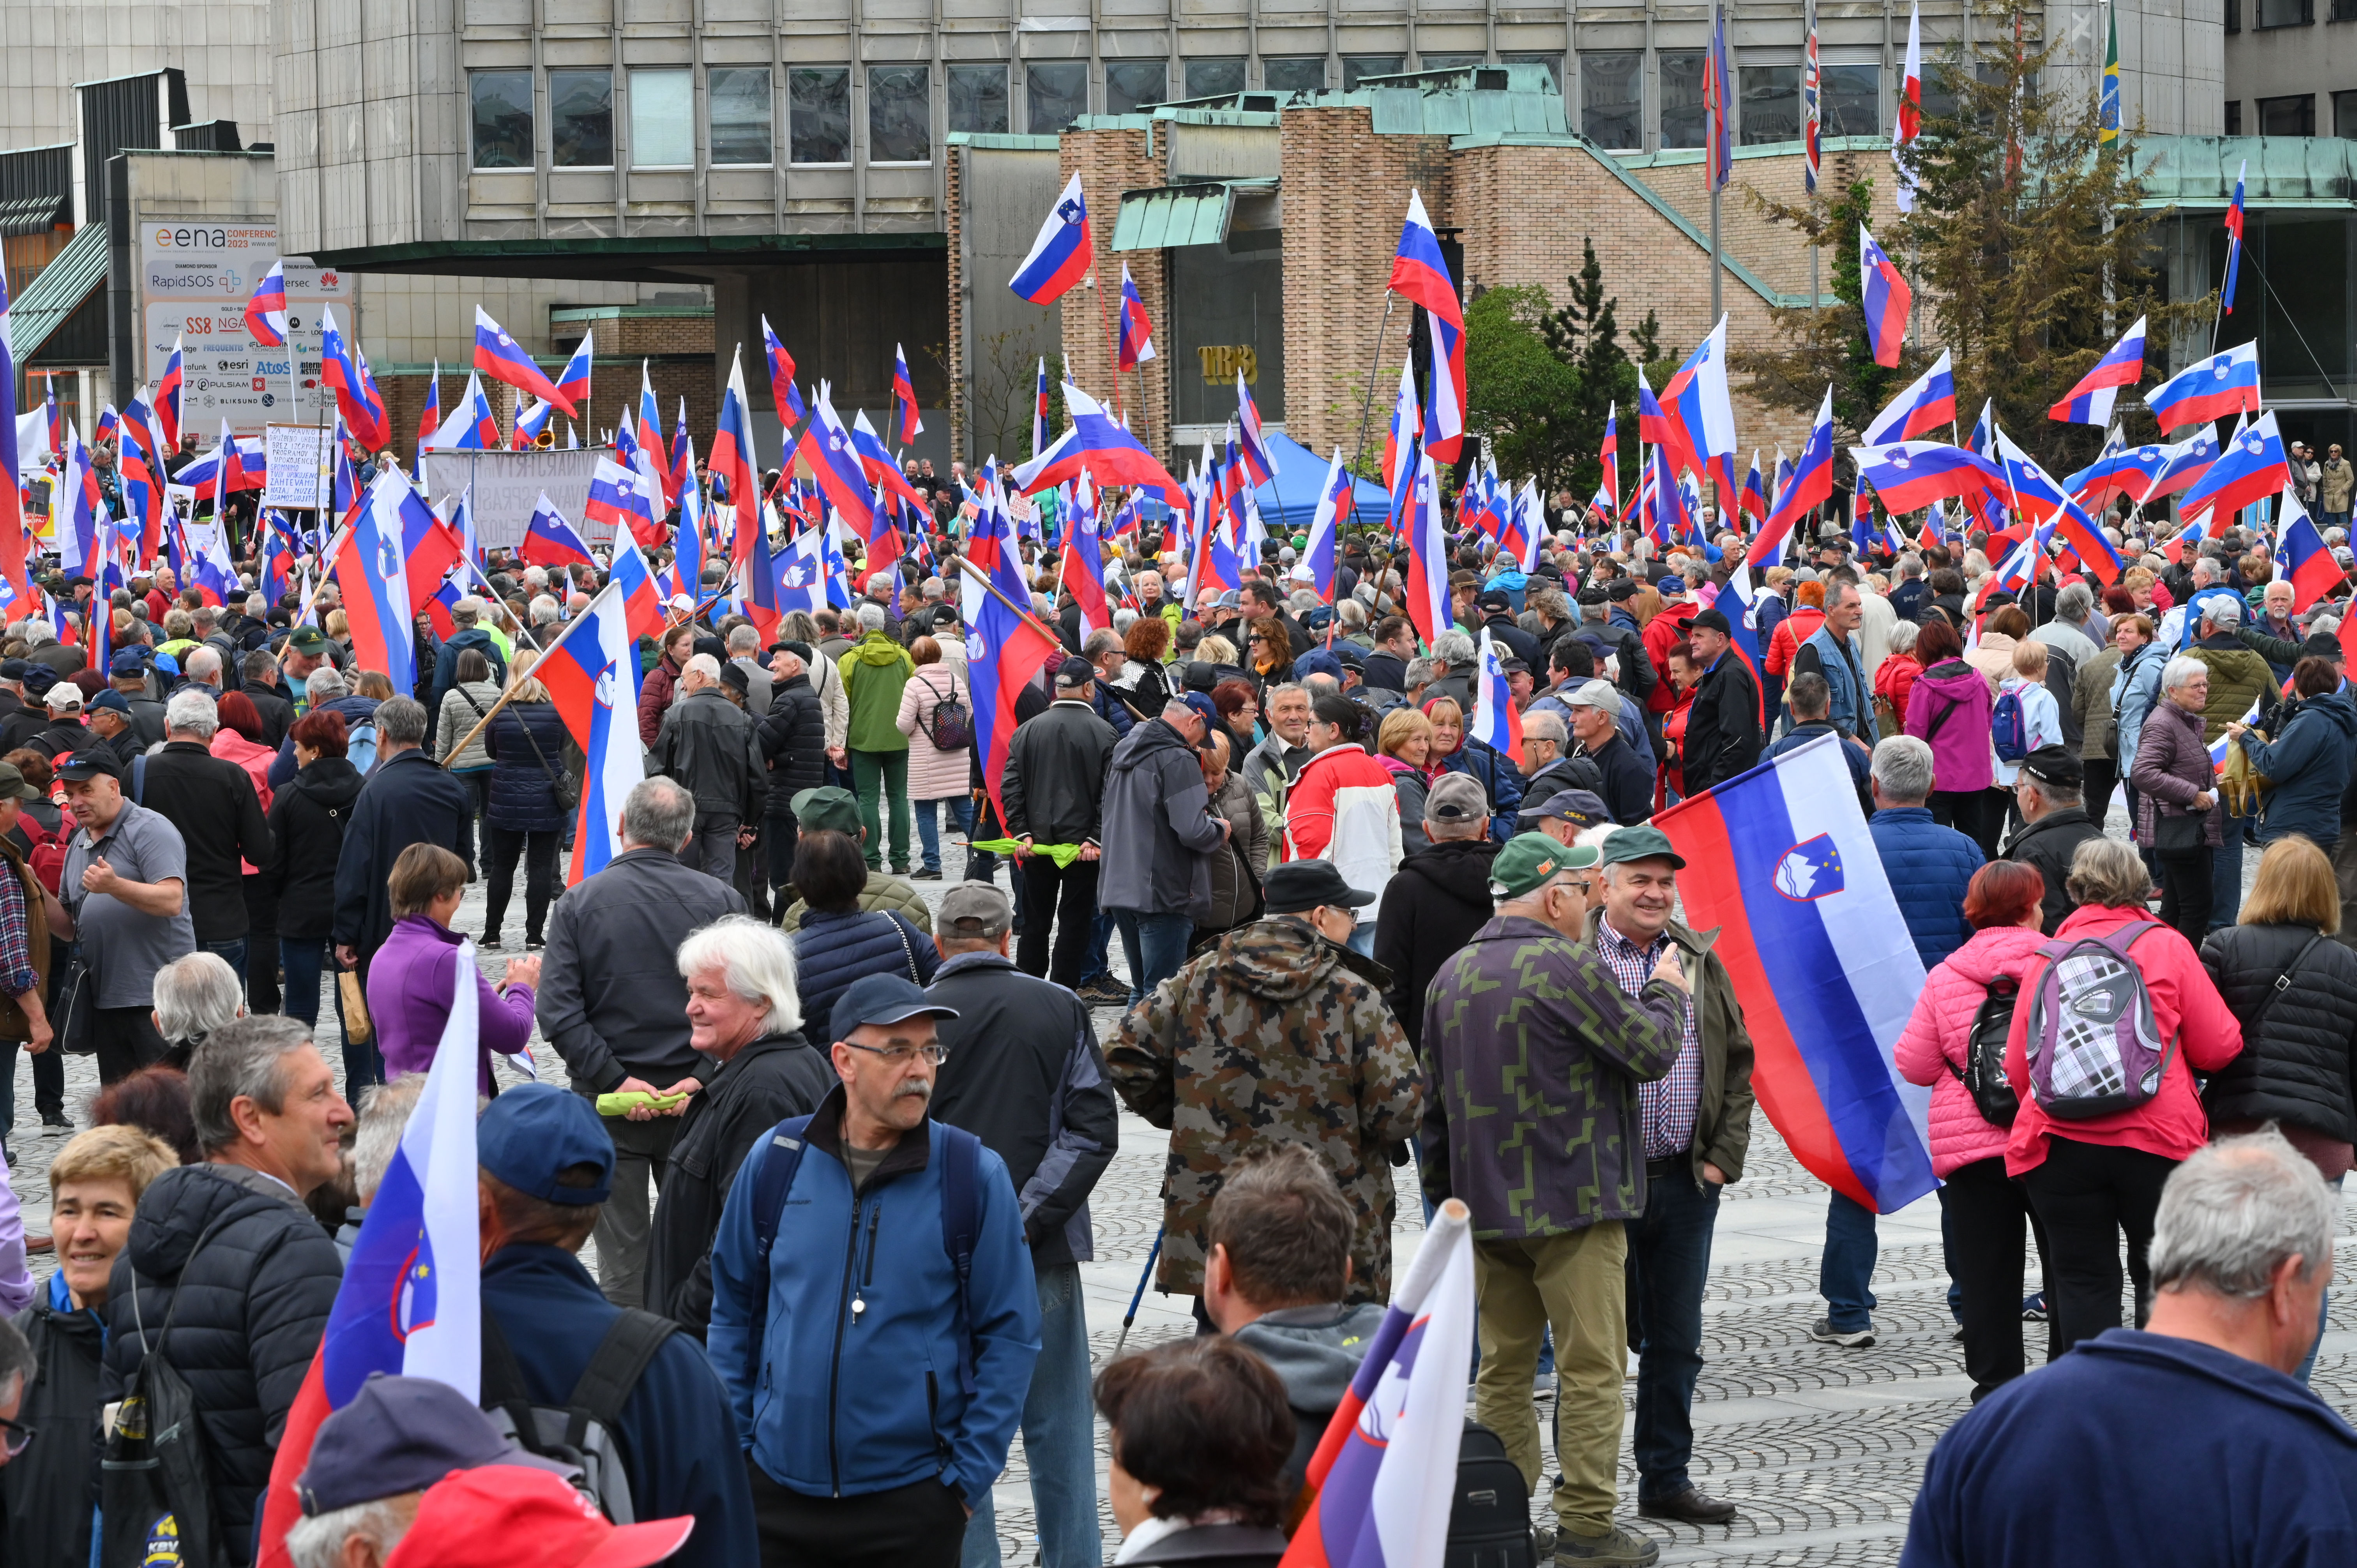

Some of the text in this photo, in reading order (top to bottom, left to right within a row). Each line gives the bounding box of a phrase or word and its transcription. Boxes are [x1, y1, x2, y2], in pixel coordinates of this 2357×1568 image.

[156, 229, 225, 247] eena
[227, 230, 276, 238] CONFERENC
[227, 240, 248, 248] 2023
[153, 275, 214, 290] RapidSOS
[186, 317, 212, 334] SS8
[219, 318, 247, 328] NGA
[160, 345, 197, 353] eveidge
[230, 359, 249, 369] esri
[269, 434, 297, 442] DRUŽBENO
[270, 478, 314, 486] ZAHTEVAMO
